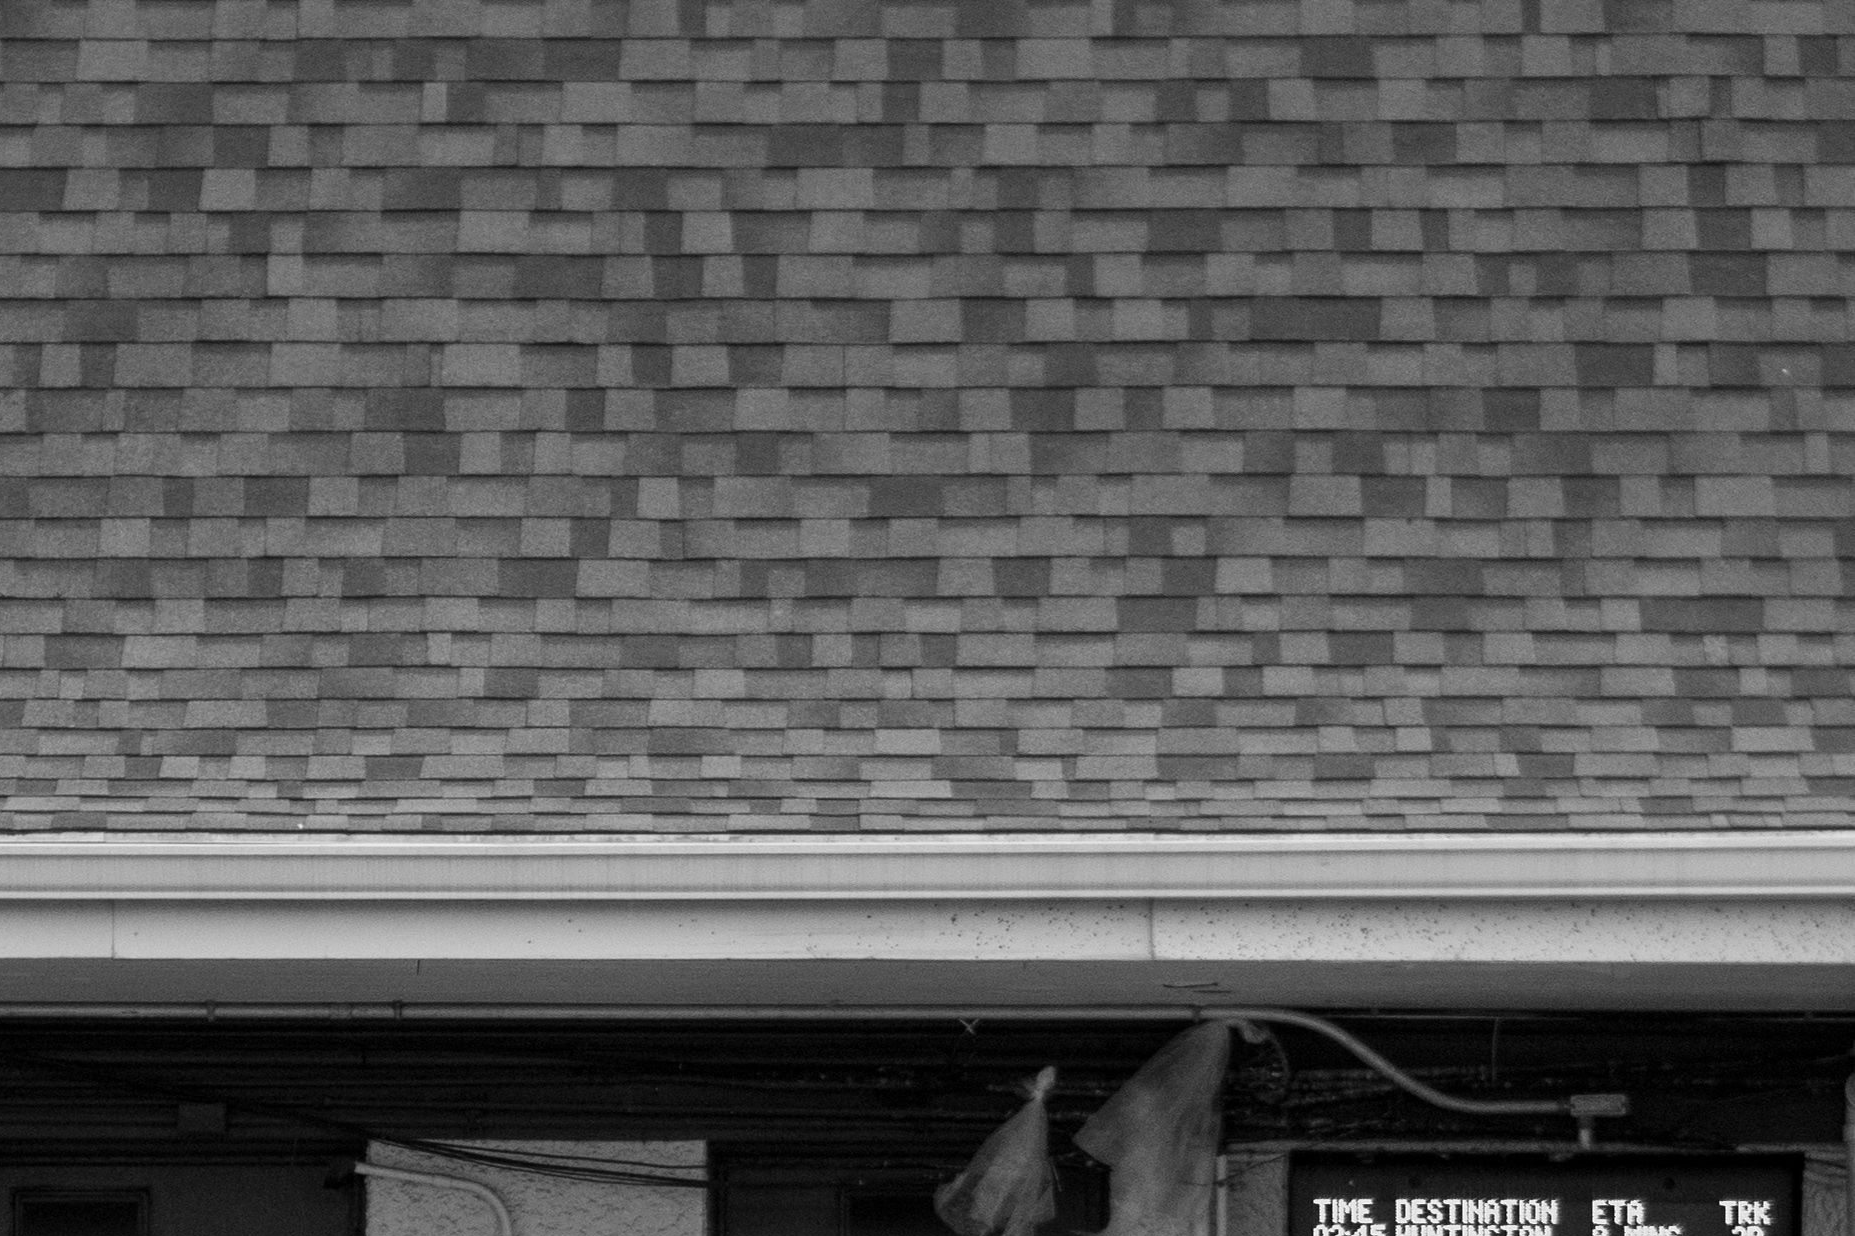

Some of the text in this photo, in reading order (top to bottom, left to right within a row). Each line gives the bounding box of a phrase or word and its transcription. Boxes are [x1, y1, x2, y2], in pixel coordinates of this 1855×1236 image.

[1312, 1199, 1773, 1224] TIME DESTINATION ETA TRK
